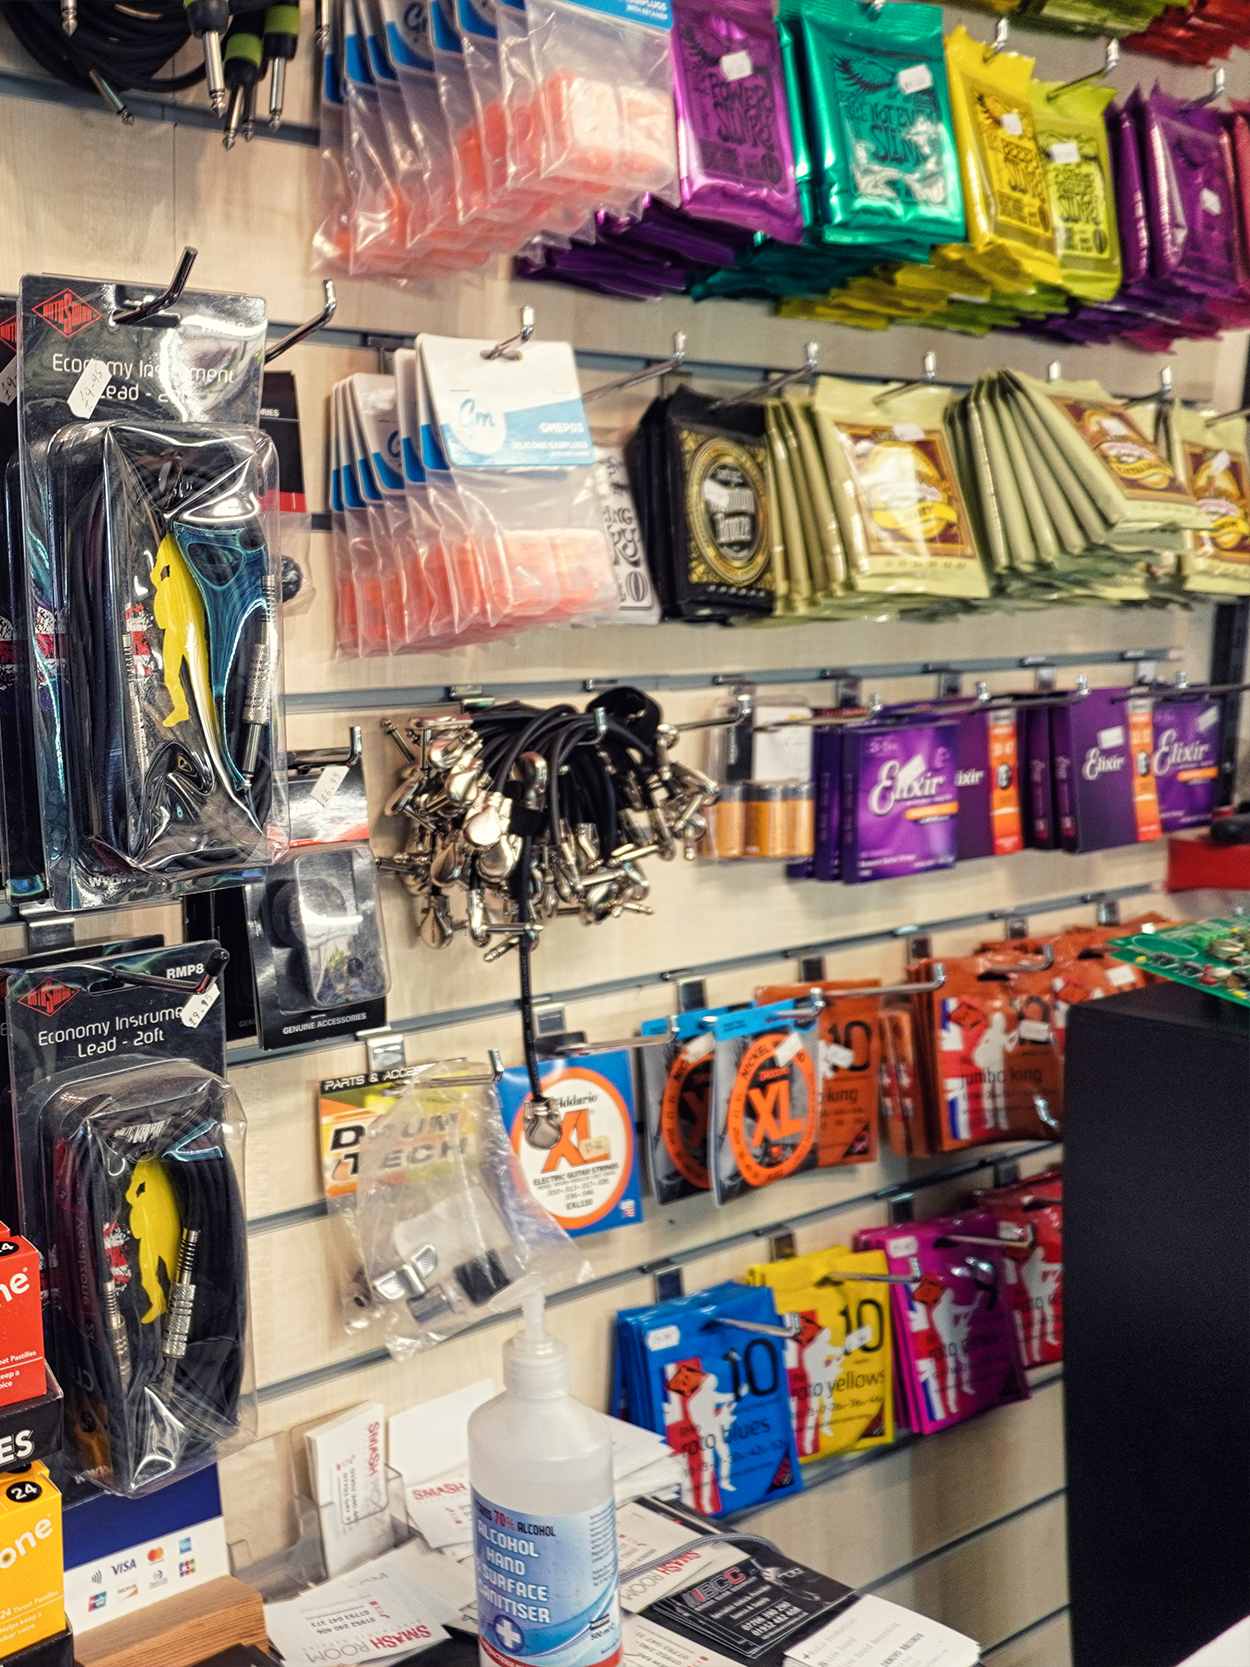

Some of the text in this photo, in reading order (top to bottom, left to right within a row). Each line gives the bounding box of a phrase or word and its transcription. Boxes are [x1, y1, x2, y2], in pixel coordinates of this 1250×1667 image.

[166, 964, 204, 979] RMP8
[38, 1021, 110, 1047] Economy
[283, 1012, 367, 1034] GENUINE ACCESSORIES
[78, 1036, 117, 1058] Lead
[325, 1073, 378, 1090] PARTS &
[748, 1079, 805, 1147] XL
[541, 1108, 611, 1174] XL
[533, 1174, 565, 1186] ELECTRIC
[567, 1168, 590, 1179] GUITAR
[592, 1163, 619, 1173] STRINGS
[839, 1299, 884, 1355] 10
[10, 1350, 36, 1362] Pastilles
[723, 1338, 778, 1402] 10
[828, 1370, 885, 1398] yellows
[682, 1419, 771, 1458] roto blues
[11, 1483, 38, 1500] 24
[411, 1482, 466, 1501] SMASH
[478, 1520, 540, 1558] ALCOHOL
[517, 1522, 556, 1537] ALCOHOL
[111, 1558, 137, 1575] VISA
[486, 1547, 526, 1576] HAND
[482, 1564, 548, 1602] SURFACE
[478, 1579, 550, 1624] SANITISER
[0, 1608, 12, 1619] 24
[370, 1625, 431, 1649] SMASH
[305, 1641, 370, 1663] ROOM
